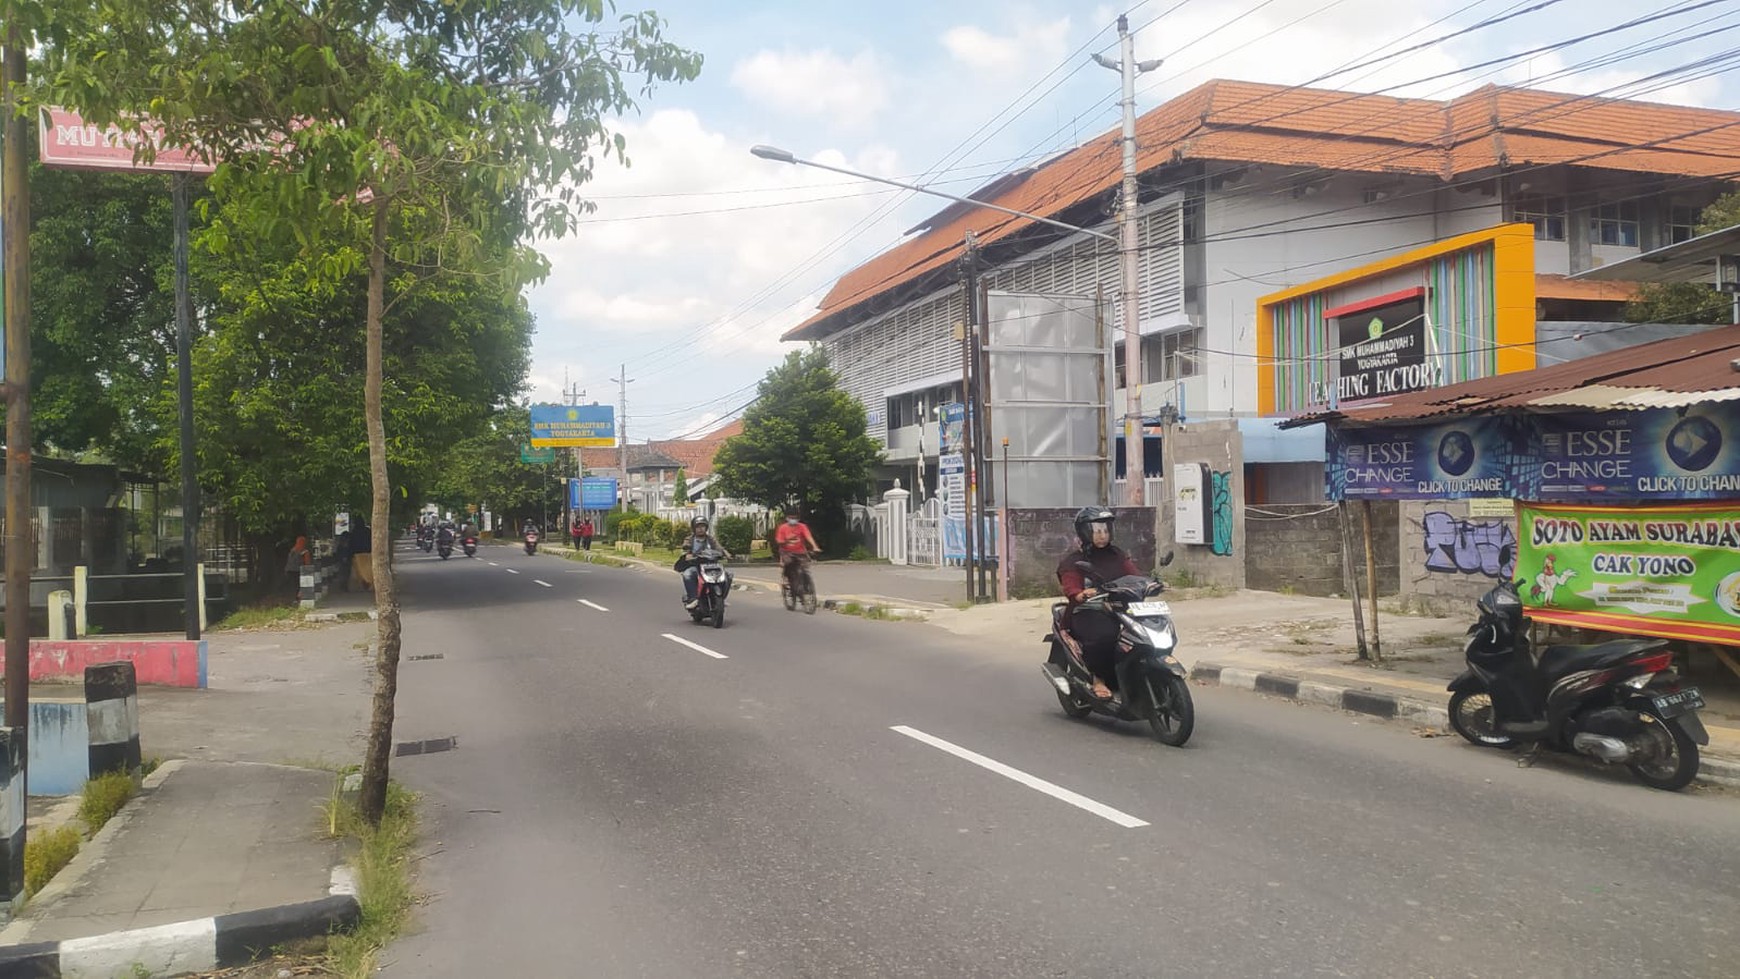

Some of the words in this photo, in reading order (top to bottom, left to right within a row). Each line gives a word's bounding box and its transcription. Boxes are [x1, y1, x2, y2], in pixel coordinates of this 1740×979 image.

[1341, 347, 1356, 360] SMK
[1356, 336, 1409, 357] MUHAMMADIYAH
[1409, 334, 1414, 347] 3
[1357, 352, 1398, 370] YOGYAKARTA
[1375, 360, 1443, 394] FACTORY
[1367, 441, 1414, 465] ESSE
[1567, 429, 1633, 457] ESSE
[1344, 466, 1415, 484] CHANGE
[1541, 460, 1633, 479] CHANGE
[1418, 480, 1445, 494] CLICK
[1446, 480, 1458, 493] TO
[1460, 478, 1502, 493] CHANGE
[1637, 476, 1677, 492] CLICK
[1679, 476, 1697, 491] TO
[1533, 517, 1584, 546] SOTO
[1589, 521, 1642, 542] AYAM
[1593, 554, 1632, 574] CAK
[1638, 556, 1695, 576] YONO
